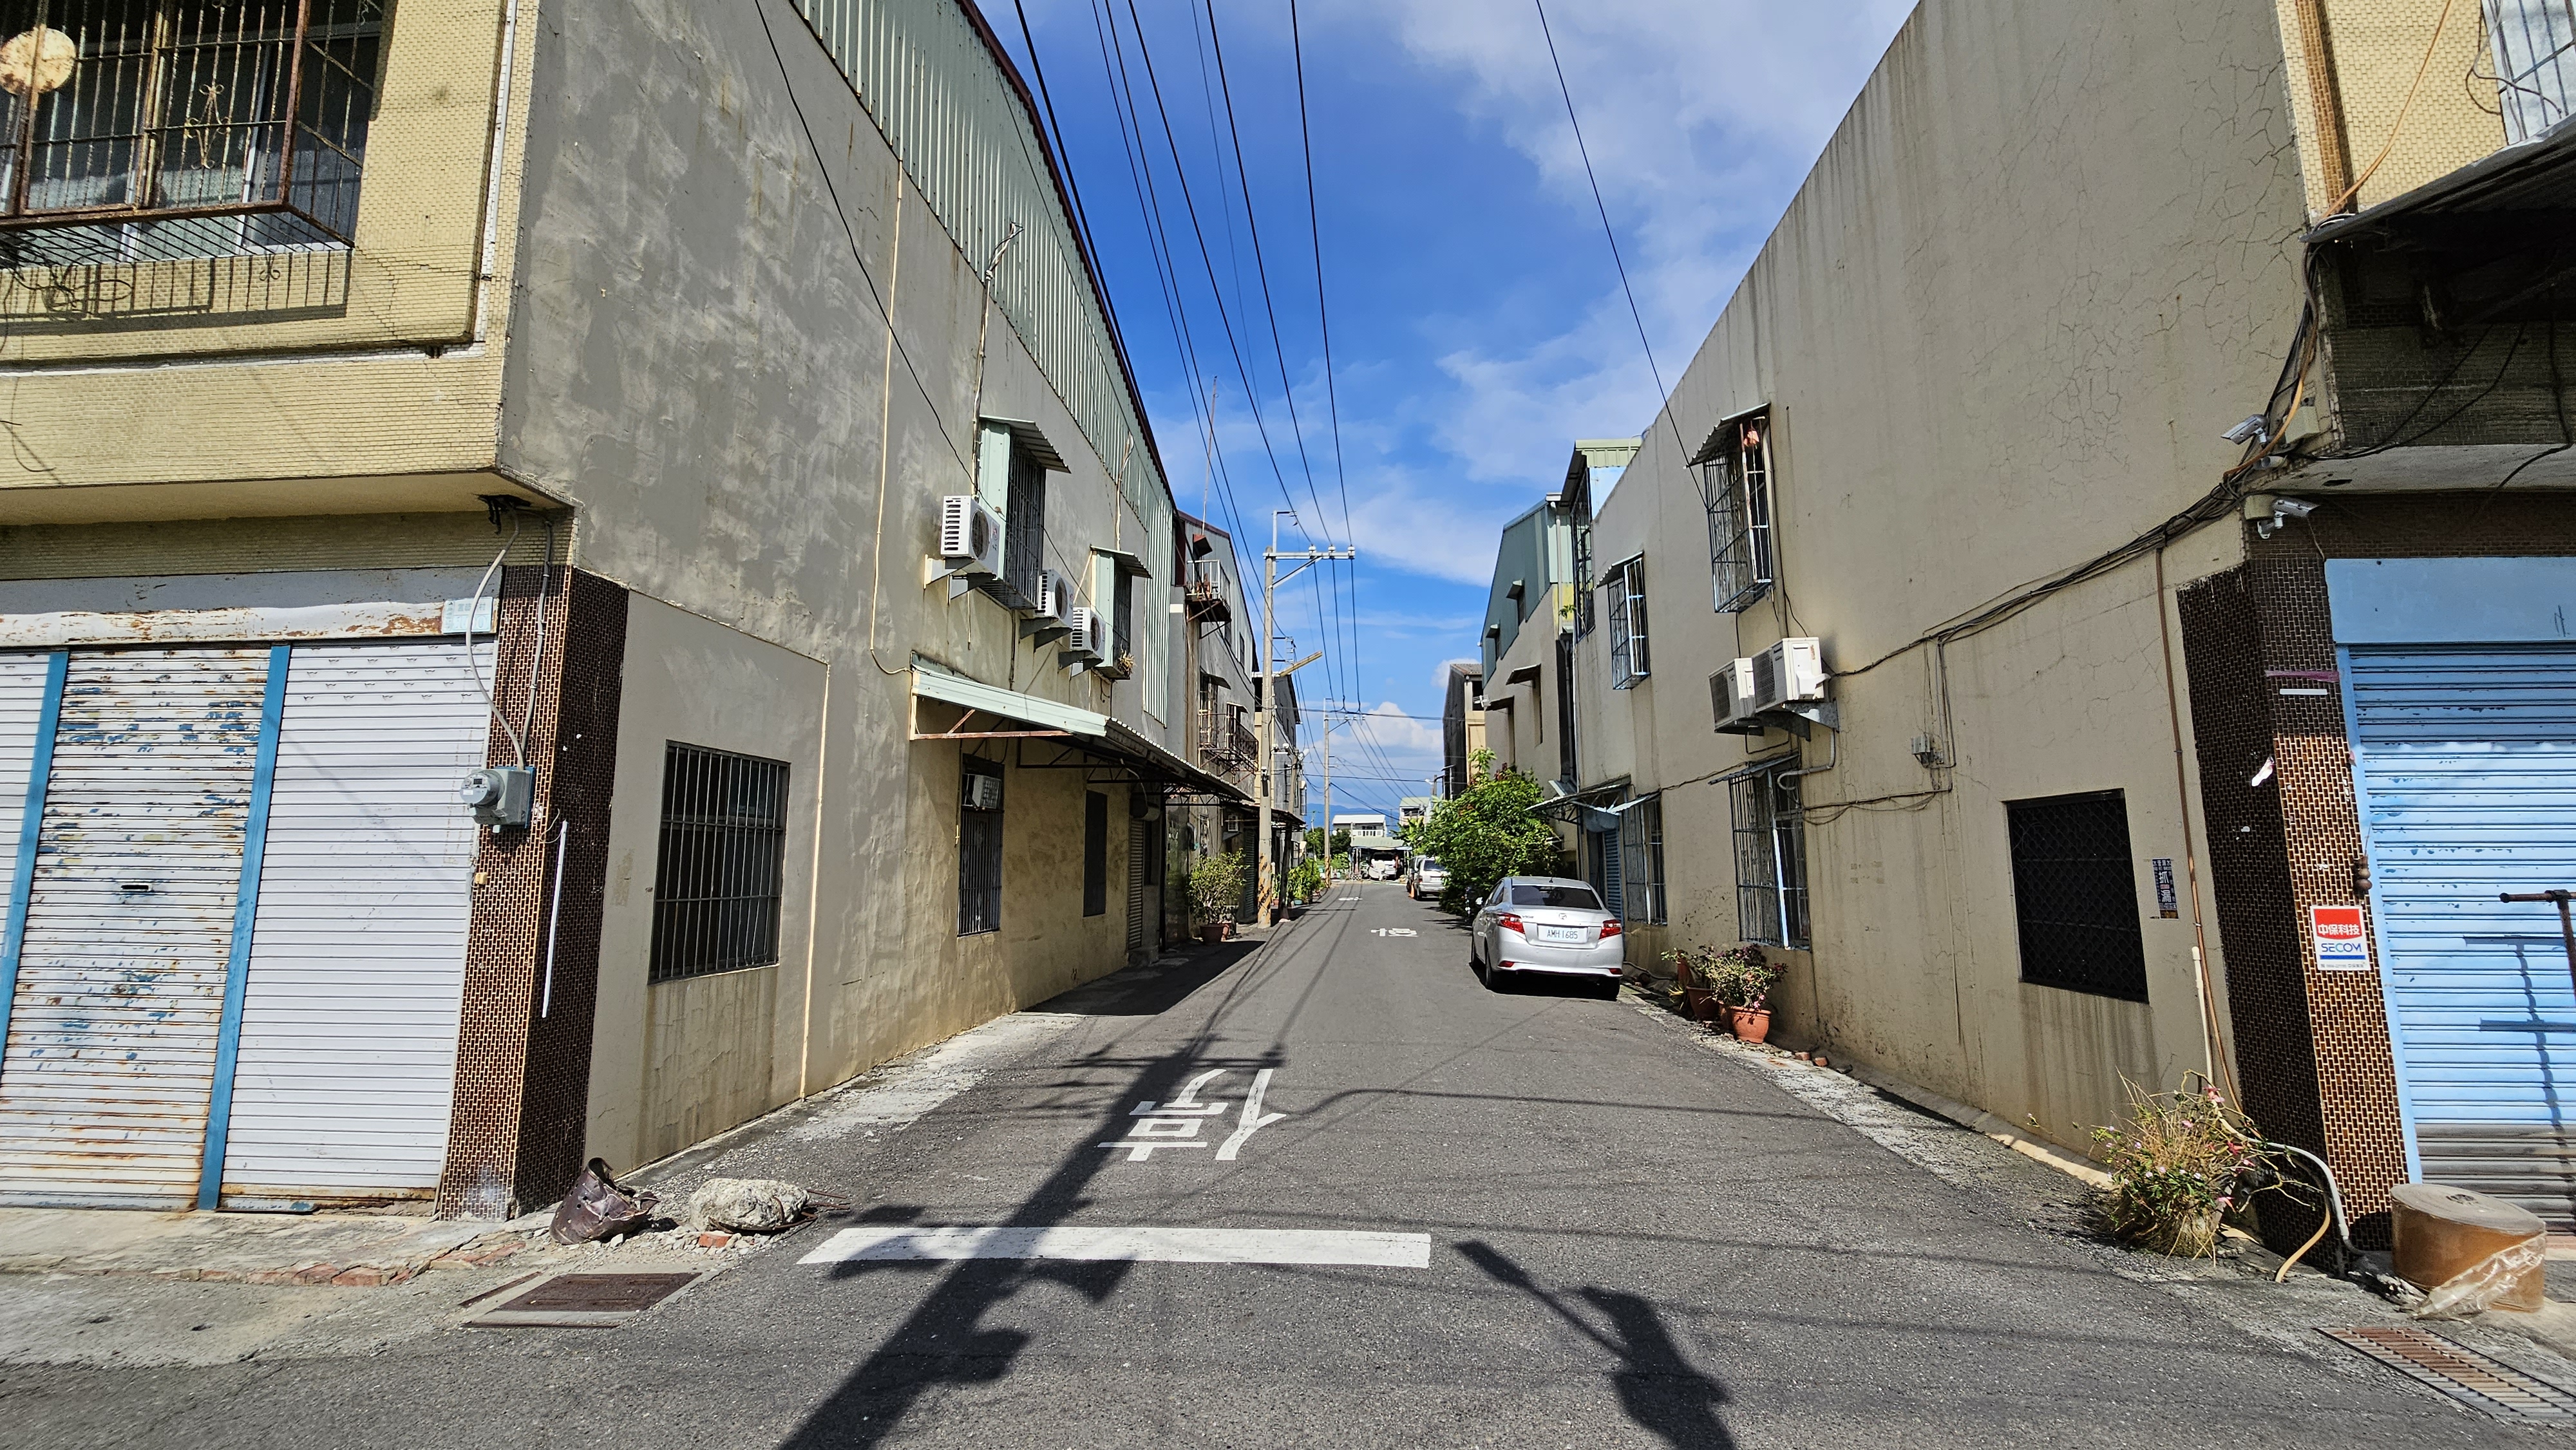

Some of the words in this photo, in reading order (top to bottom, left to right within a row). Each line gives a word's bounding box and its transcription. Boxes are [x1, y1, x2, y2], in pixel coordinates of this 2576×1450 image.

[2318, 924, 2360, 935] 中保科技
[2321, 943, 2362, 952] SECOM
[1097, 1068, 1287, 1162] 停
